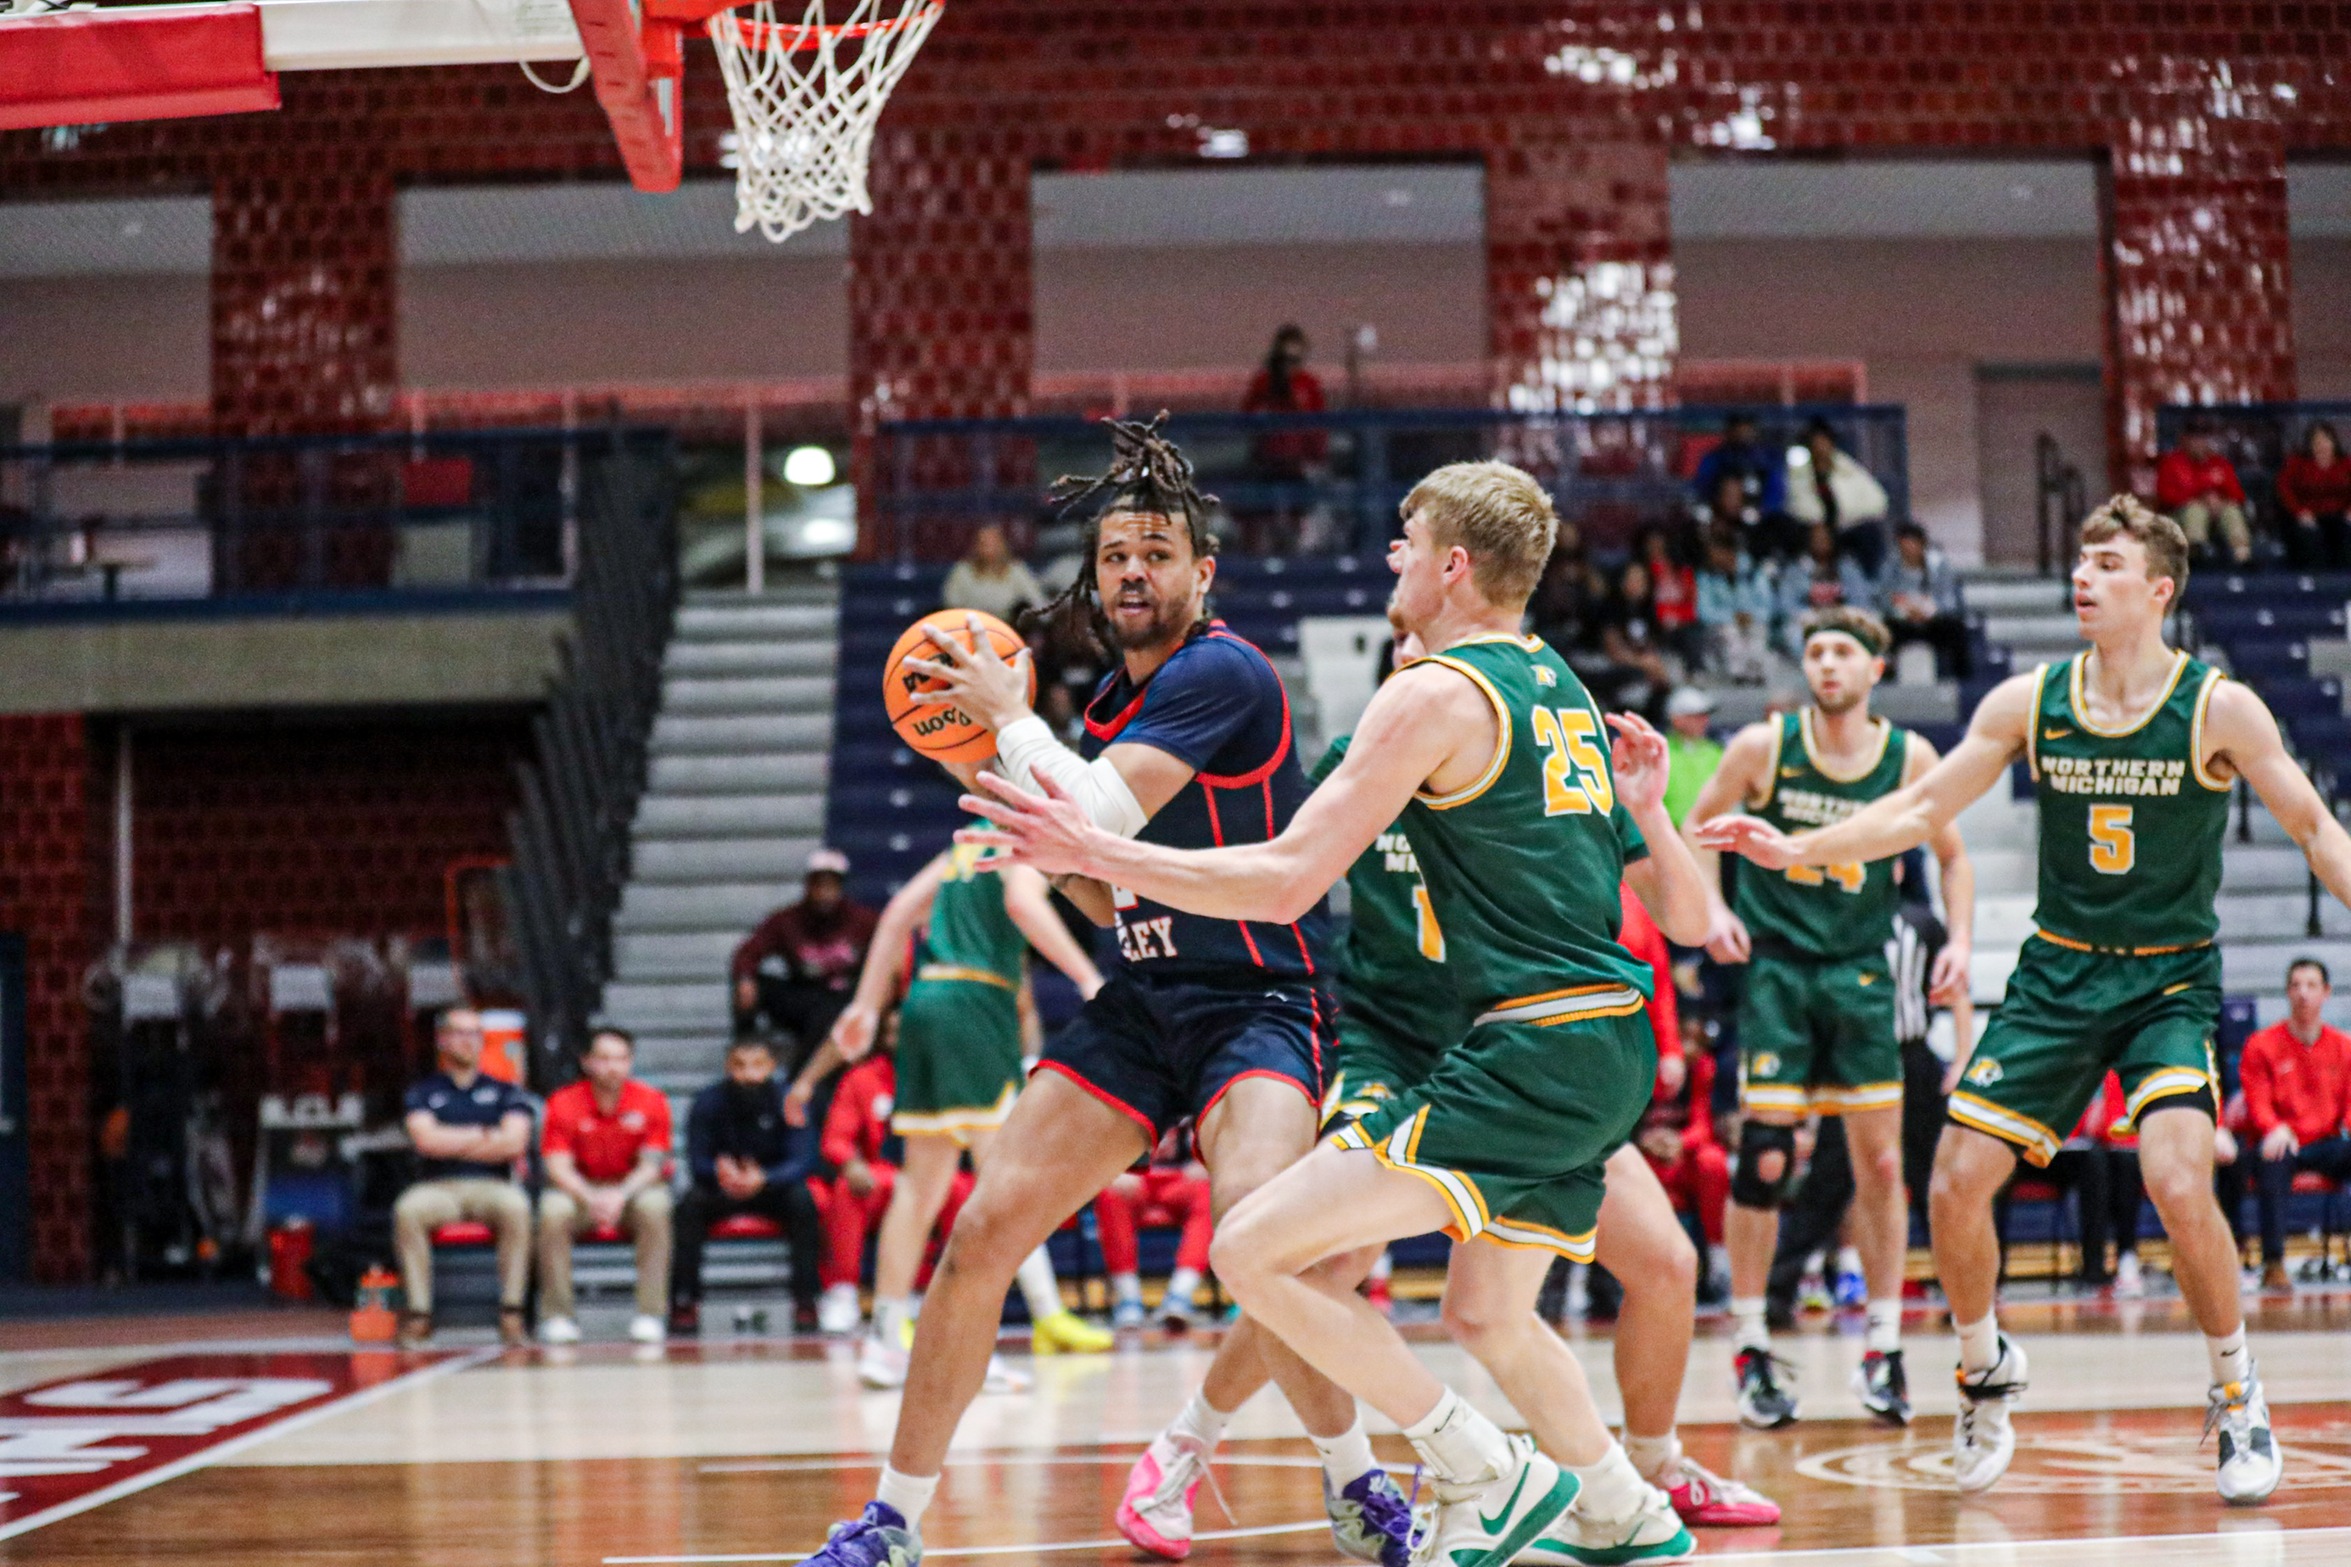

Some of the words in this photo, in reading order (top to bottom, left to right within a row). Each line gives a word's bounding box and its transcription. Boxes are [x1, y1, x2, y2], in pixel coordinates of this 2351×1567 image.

[912, 706, 972, 737] lson
[1531, 704, 1614, 817] 25
[2041, 756, 2186, 778] NORTHERN
[2051, 775, 2181, 796] MICHIGAN
[2089, 803, 2135, 875] 5
[1115, 914, 1178, 962] LEY
